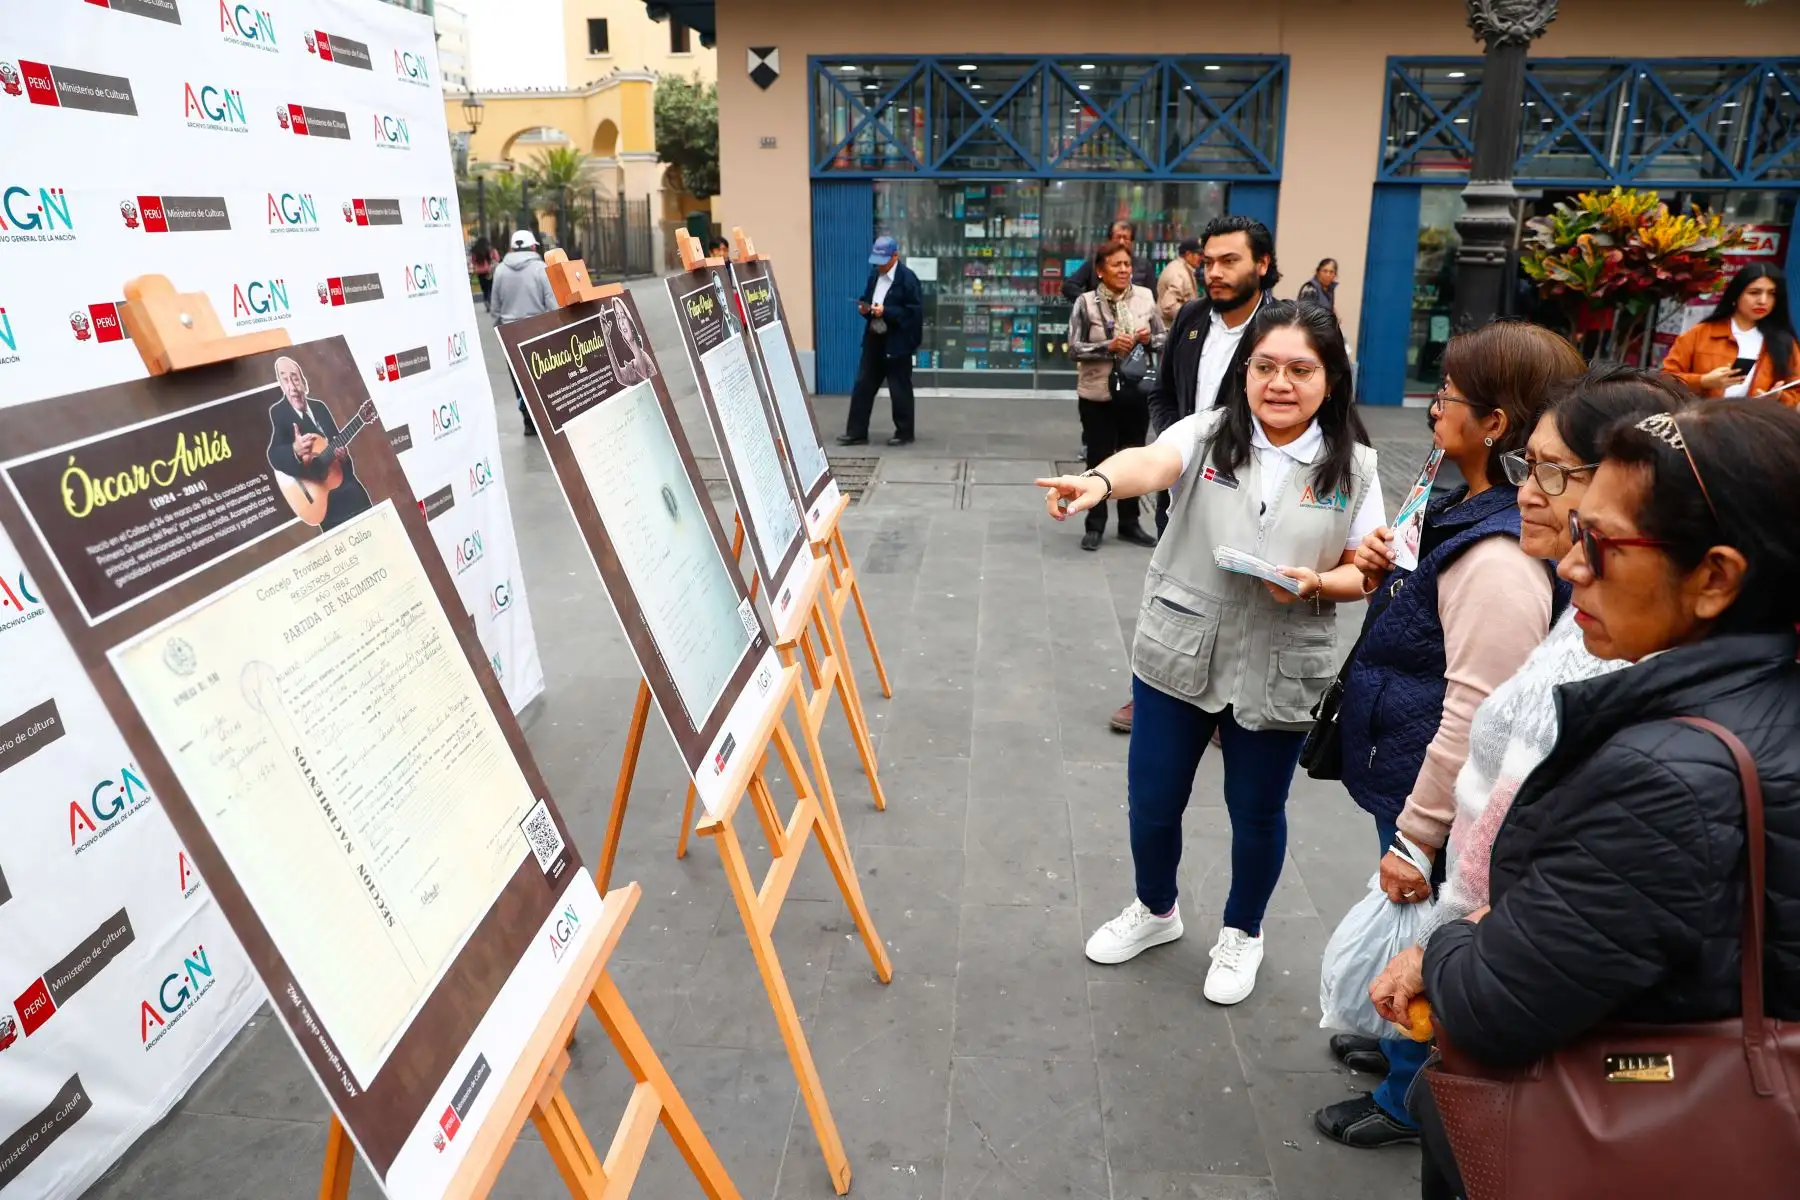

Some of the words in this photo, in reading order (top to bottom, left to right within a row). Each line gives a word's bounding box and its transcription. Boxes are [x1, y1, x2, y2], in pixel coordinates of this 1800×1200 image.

[220, 0, 276, 45] AGN
[28, 77, 51, 91] PERÚ
[394, 49, 428, 81] AGN
[58, 82, 94, 96] Ministerio
[94, 87, 104, 97] de
[105, 89, 130, 101] Cultura
[185, 82, 246, 124] AGN
[374, 114, 410, 144] AGN
[0, 186, 73, 230] GN
[144, 207, 162, 219] PERÚ
[167, 208, 196, 218] Ministerio
[197, 209, 204, 217] de
[205, 208, 225, 217] Cultura
[268, 193, 317, 224] AGN
[405, 263, 437, 292] AGN
[233, 279, 290, 318] AGN
[96, 314, 116, 328] PERÚ
[432, 400, 460, 434] AGN
[61, 455, 151, 518] Óscar
[150, 430, 233, 487] Avilés
[256, 577, 291, 602] Concejo
[292, 550, 332, 580] Provincial
[334, 542, 347, 557] del
[349, 529, 372, 547] Callao
[290, 573, 331, 601] REGISTROS
[333, 554, 359, 576] CIVILES
[282, 611, 322, 644] PARTIDA
[322, 601, 338, 618] DE
[336, 567, 388, 608] NACIMIENTO
[15, 733, 27, 744] de
[27, 717, 55, 737] Cultura
[292, 746, 355, 855] NACIMIENTOS
[74, 838, 98, 855] ARCHIVO
[98, 819, 121, 840] GENERAL
[356, 862, 396, 929] SECCION
[549, 904, 580, 958] AGN
[52, 955, 92, 992] Ministerio
[92, 945, 102, 959] de
[102, 924, 127, 950] Cultura
[24, 993, 47, 1020] PERÚ
[142, 945, 212, 1043] AGN
[145, 1028, 167, 1052] ARCHIVO
[166, 1007, 188, 1030] GENERAL
[41, 1121, 54, 1134] de
[55, 1092, 82, 1122] Cultura
